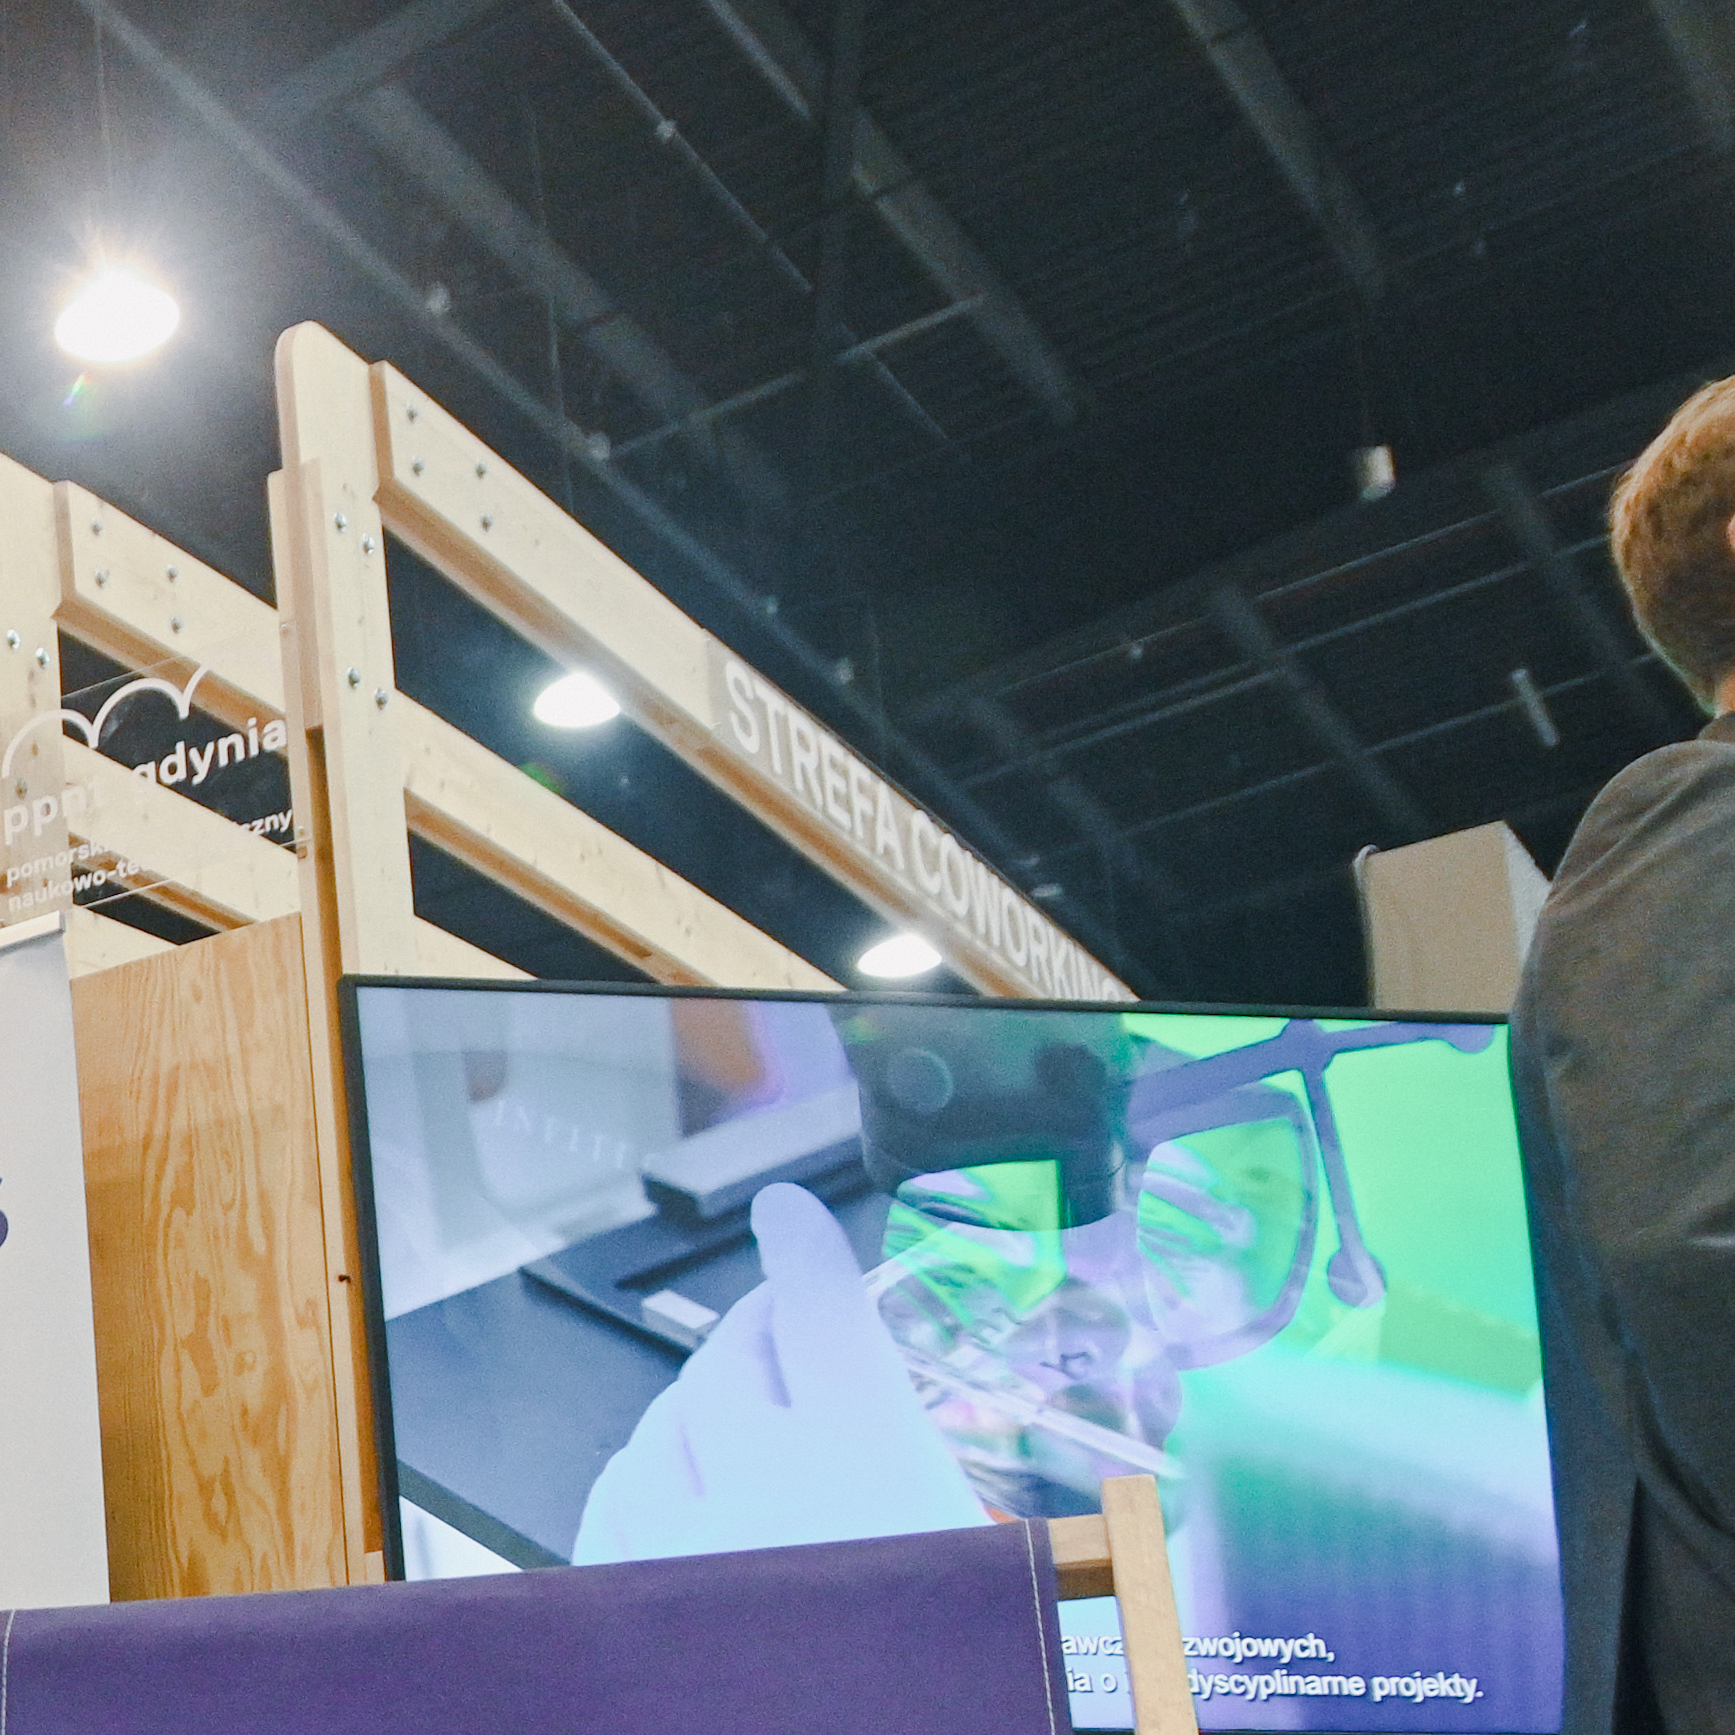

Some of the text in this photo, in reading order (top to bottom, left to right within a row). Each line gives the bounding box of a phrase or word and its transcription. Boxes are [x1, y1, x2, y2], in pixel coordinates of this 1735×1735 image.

[725, 660, 905, 872] STREFA
[1182, 1633, 1335, 1663] zwojowych,
[1067, 1669, 1093, 1693] ia
[1187, 1668, 1366, 1701] dyscyplinarne
[1372, 1671, 1485, 1704] projekty.
